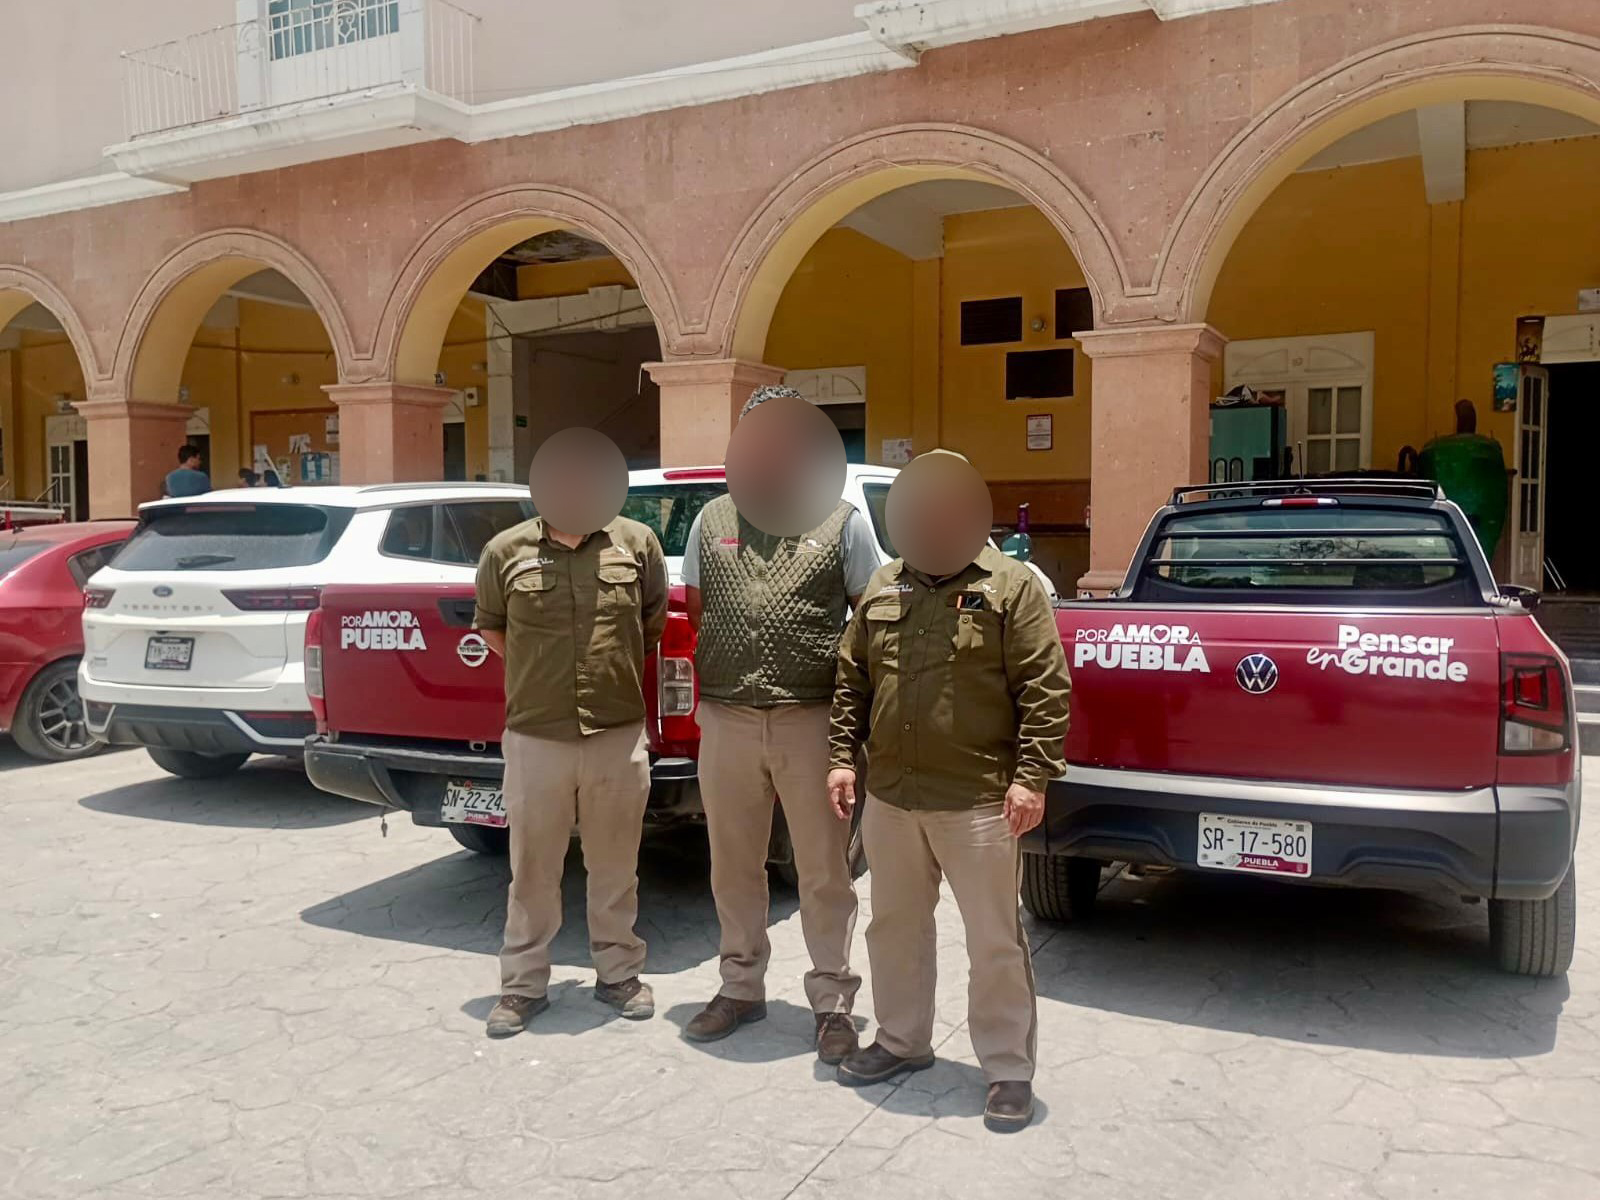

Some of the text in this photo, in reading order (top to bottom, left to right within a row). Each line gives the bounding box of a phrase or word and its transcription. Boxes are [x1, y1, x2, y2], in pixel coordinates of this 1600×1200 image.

[341, 615, 362, 627] POR
[360, 610, 413, 627] AMOR
[341, 628, 427, 651] PUEBLA
[1075, 623, 1202, 645] POR AMOR A
[1337, 624, 1455, 656] Pensar
[1074, 643, 1211, 673] PUEBLA
[1306, 647, 1468, 682] en Grande
[1202, 827, 1307, 858] SR-17-580
[1244, 857, 1279, 867] PUEBLA
